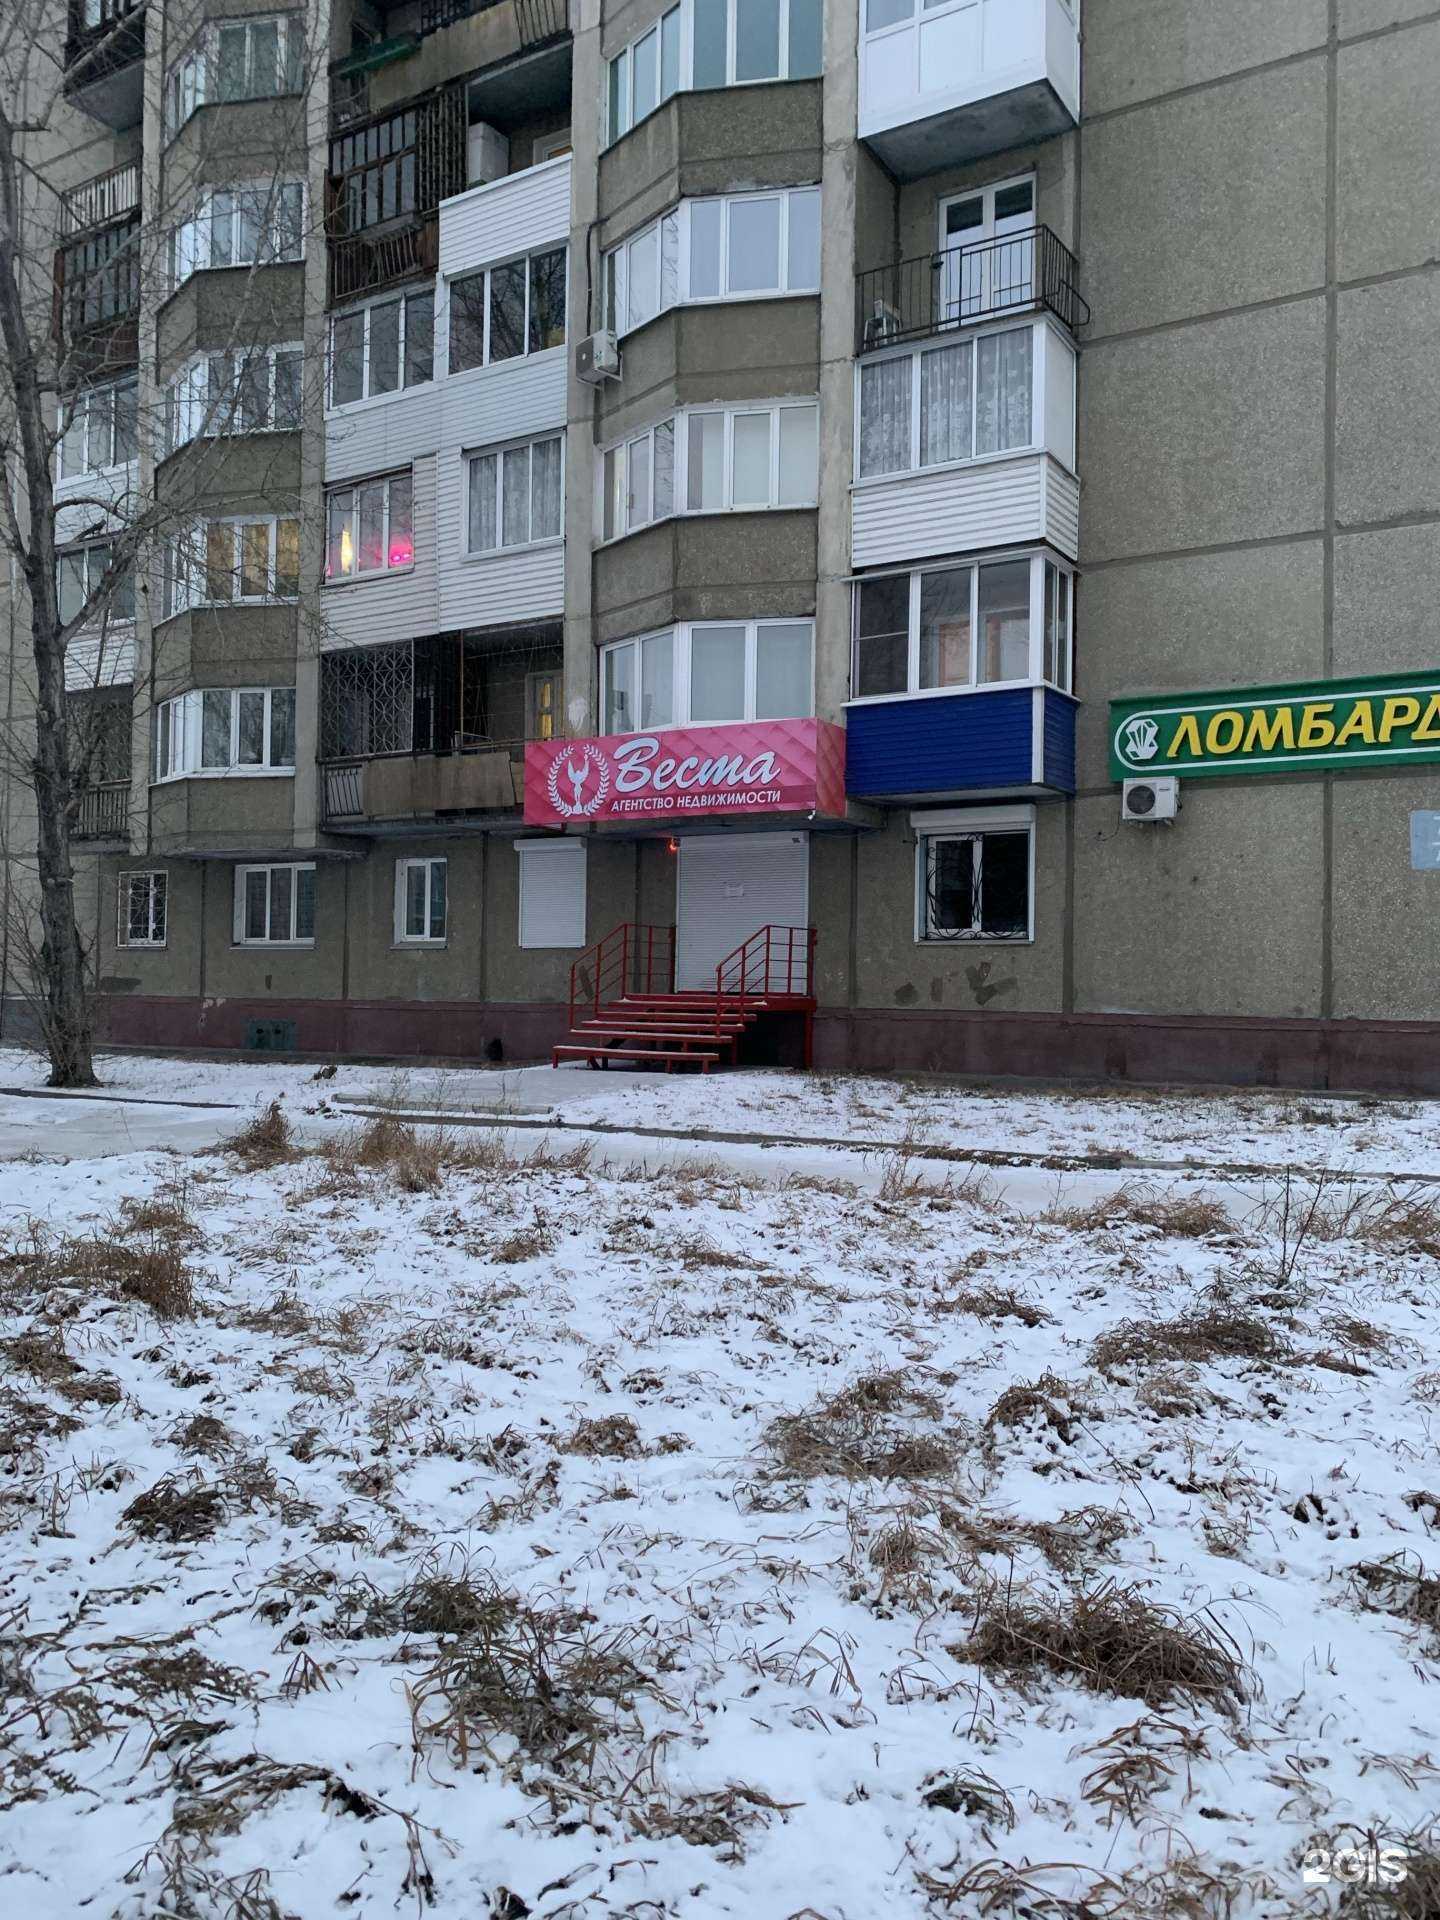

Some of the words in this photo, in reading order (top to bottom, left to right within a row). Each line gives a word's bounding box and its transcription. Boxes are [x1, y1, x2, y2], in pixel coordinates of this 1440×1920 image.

[613, 737, 781, 792] Веста
[611, 796, 674, 812] АГЕНТСТВО
[676, 790, 781, 808] НЕДВИЖИМОСТИ
